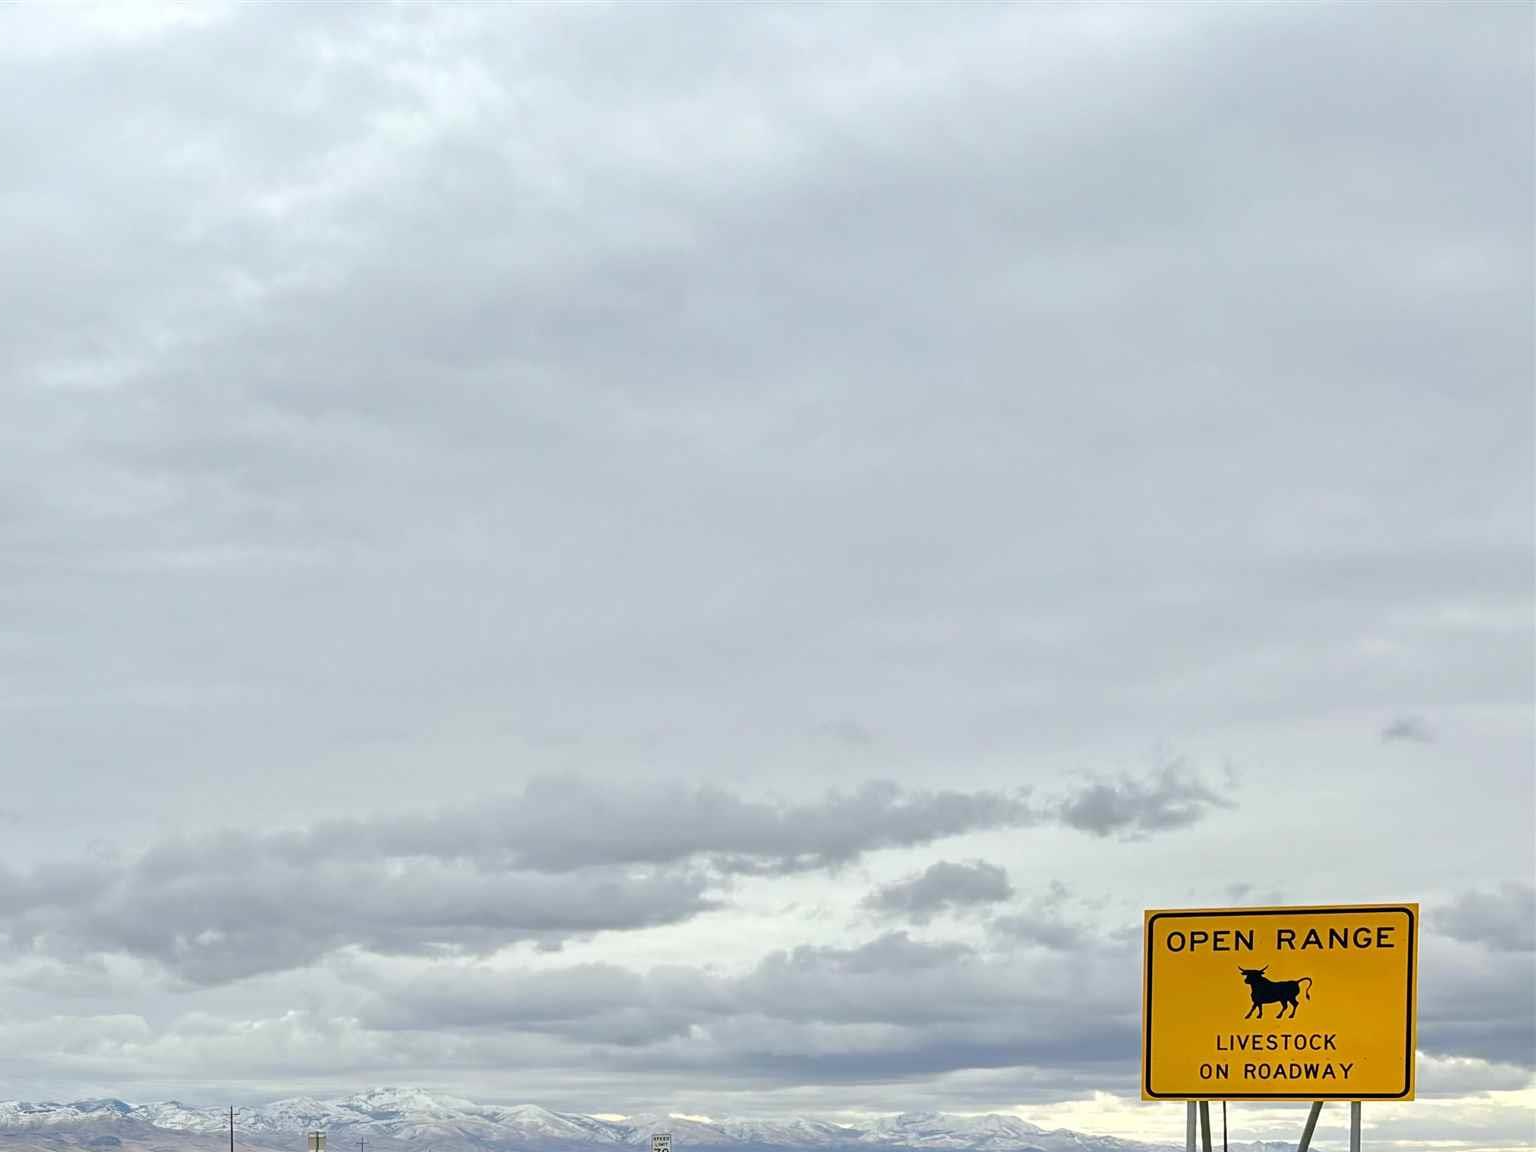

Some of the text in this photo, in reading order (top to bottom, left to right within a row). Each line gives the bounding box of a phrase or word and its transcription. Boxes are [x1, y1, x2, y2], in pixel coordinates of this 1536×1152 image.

[1166, 927, 1395, 952] OPEN RANGE
[1216, 1034, 1337, 1051] LIVESTOCK
[1200, 1063, 1354, 1079] ON ROADWAY
